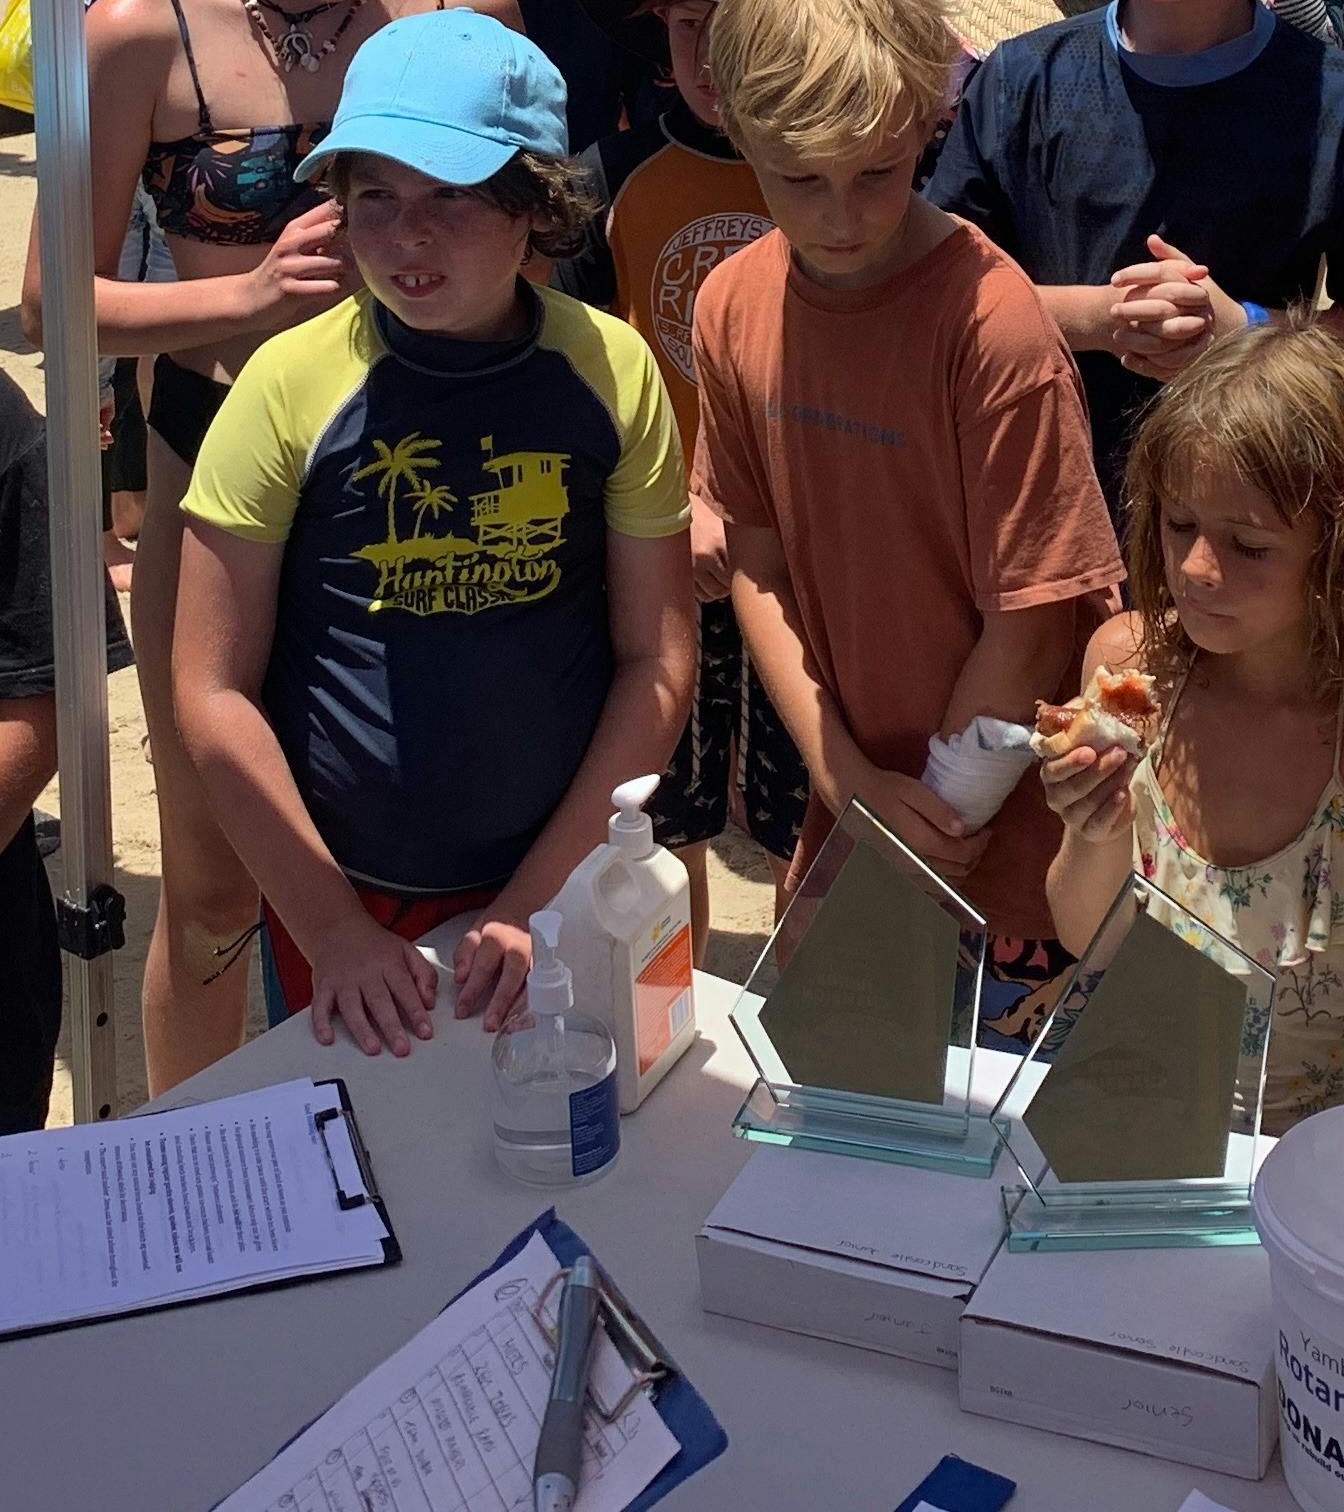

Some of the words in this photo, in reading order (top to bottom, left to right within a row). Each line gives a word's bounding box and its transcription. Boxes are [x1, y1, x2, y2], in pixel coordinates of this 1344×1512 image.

[672, 218, 764, 250] JEFFREYS
[373, 545, 561, 605] Huntington
[392, 587, 438, 612] SURF
[1121, 1398, 1194, 1427] Senior
